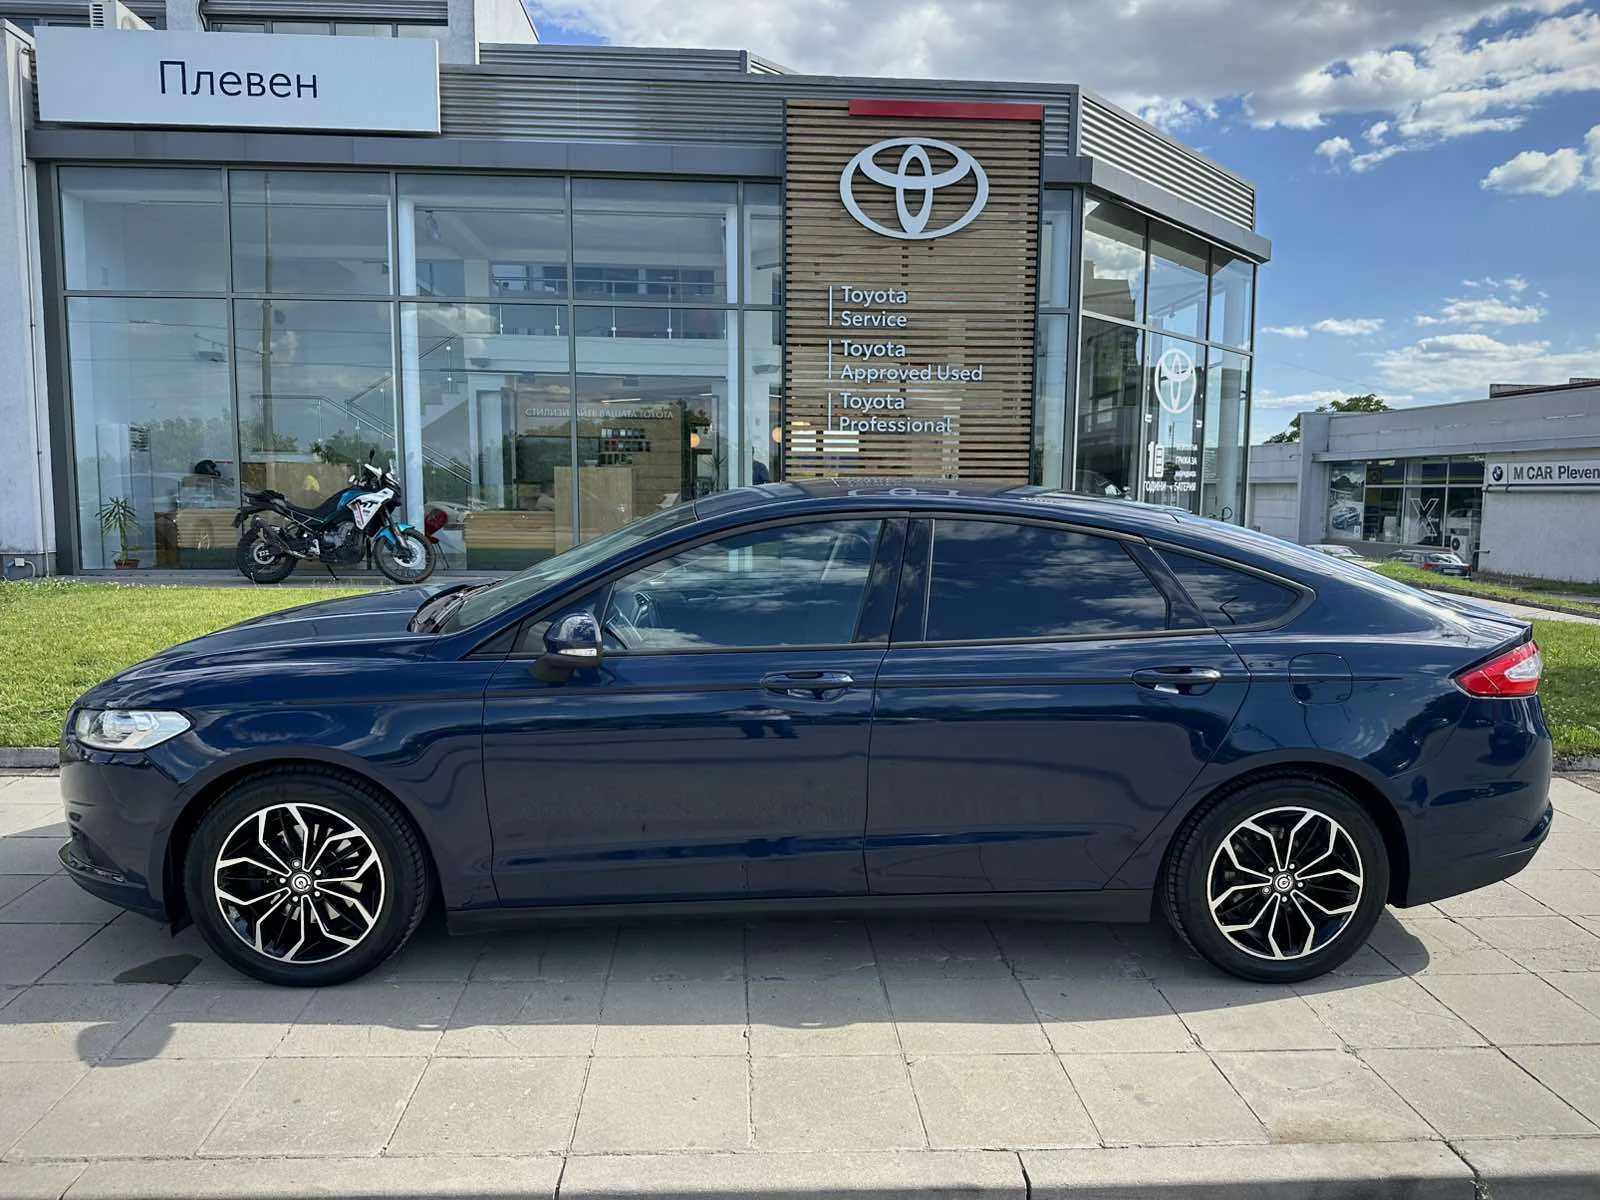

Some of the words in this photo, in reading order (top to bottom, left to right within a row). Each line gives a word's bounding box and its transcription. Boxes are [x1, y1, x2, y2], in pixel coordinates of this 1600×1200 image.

[159, 60, 318, 99] Плевен
[840, 285, 907, 307] Toyota
[840, 310, 907, 328] Service
[840, 339, 906, 361] Toyota
[840, 364, 932, 383] Approved
[936, 364, 983, 382] Used
[840, 391, 905, 413] Toyota
[839, 416, 952, 434] Professional
[1513, 466, 1524, 481] M
[1526, 466, 1553, 480] CAR
[1557, 465, 1600, 480] Pleven
